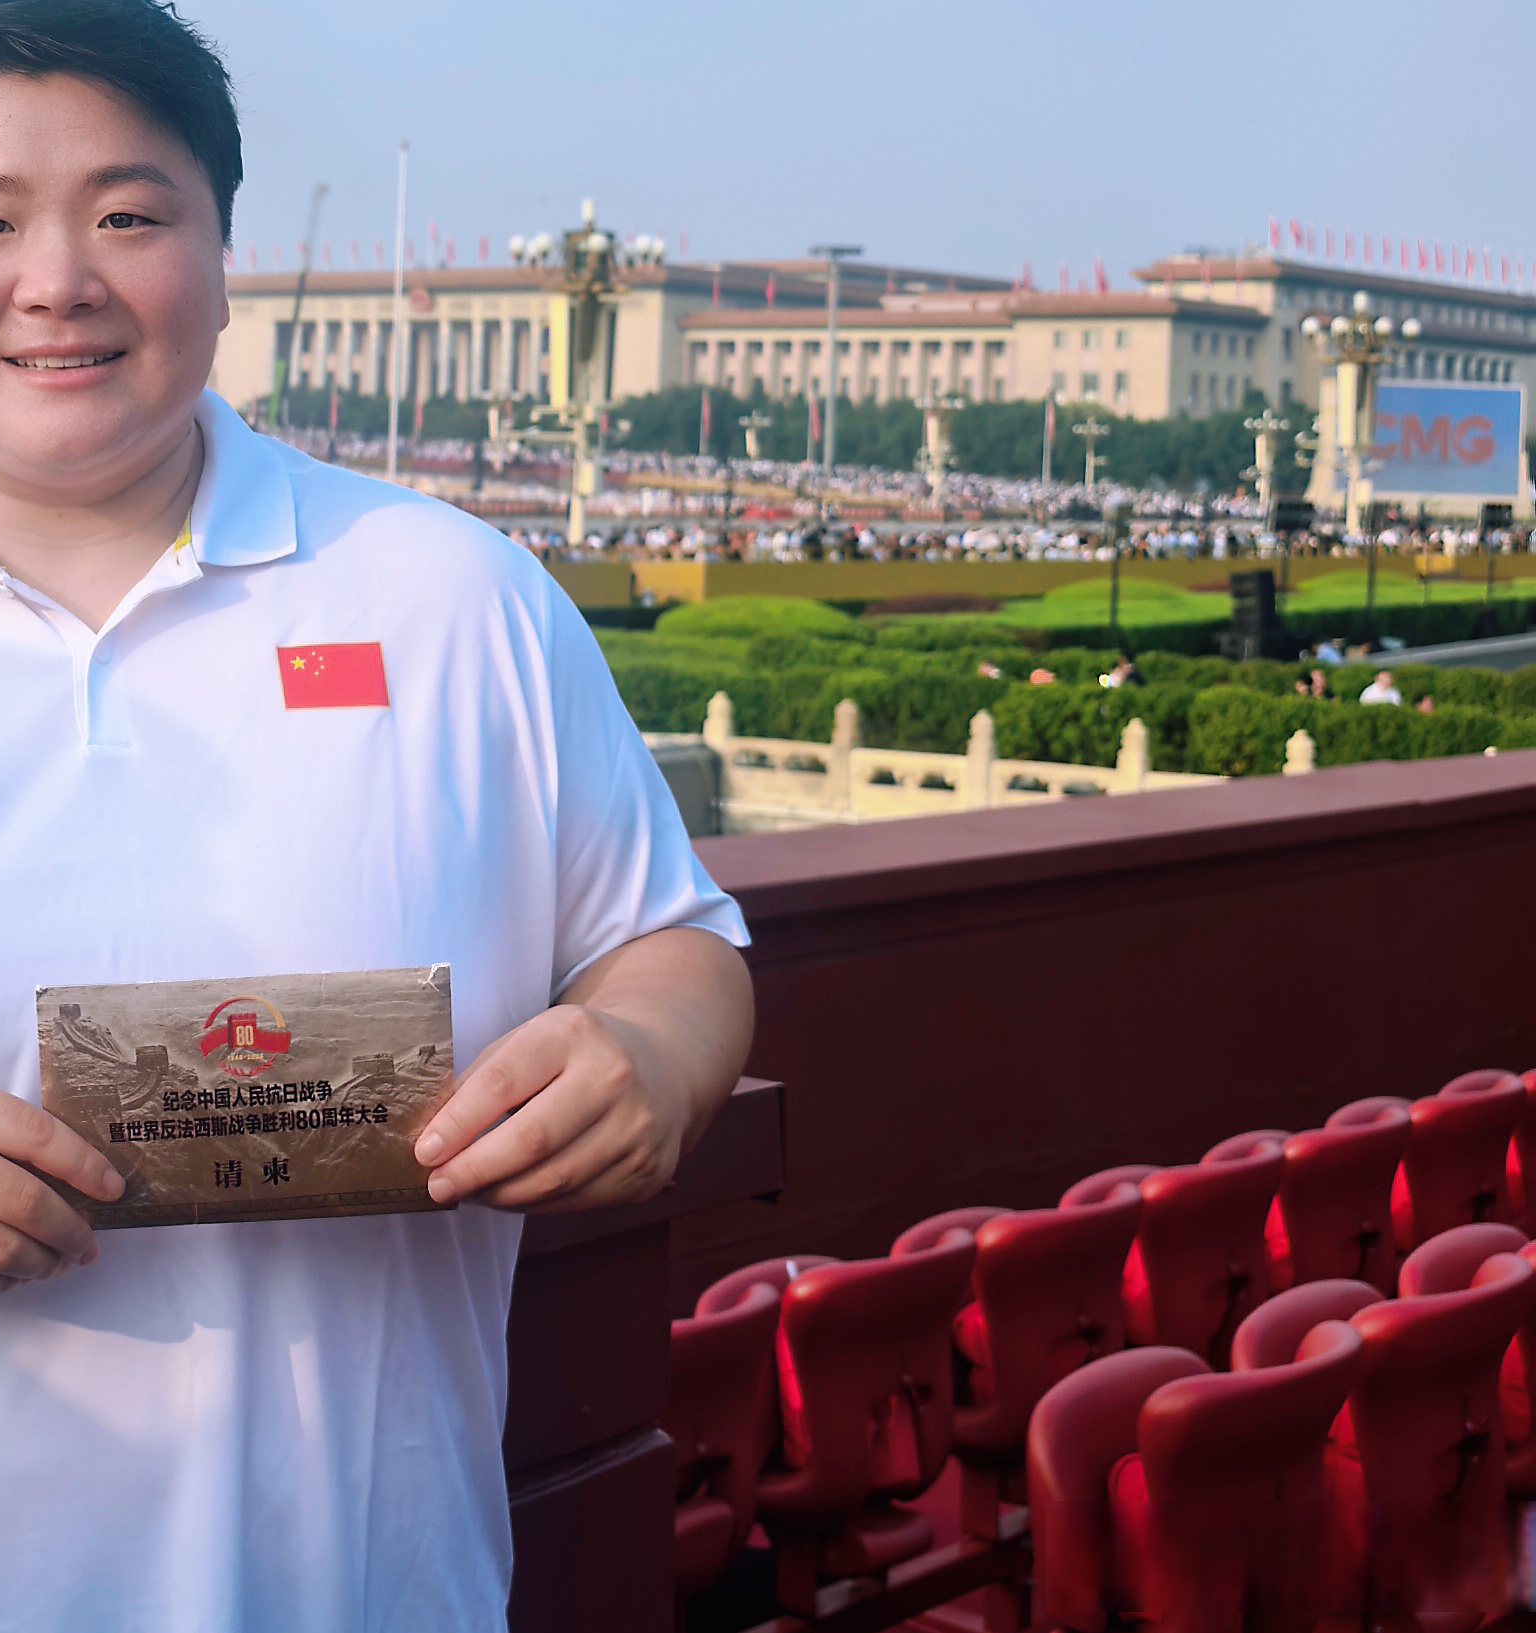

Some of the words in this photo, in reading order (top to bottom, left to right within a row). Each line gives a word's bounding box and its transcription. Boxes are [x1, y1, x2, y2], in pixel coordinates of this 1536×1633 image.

[1368, 410, 1495, 465] CMG
[236, 1025, 254, 1046] 80
[163, 1079, 333, 1112] 纪念中国人民抗日战争
[108, 1103, 389, 1143] 暨世界反法西斯战争胜利80周年大会
[213, 1156, 291, 1188] 请柬
